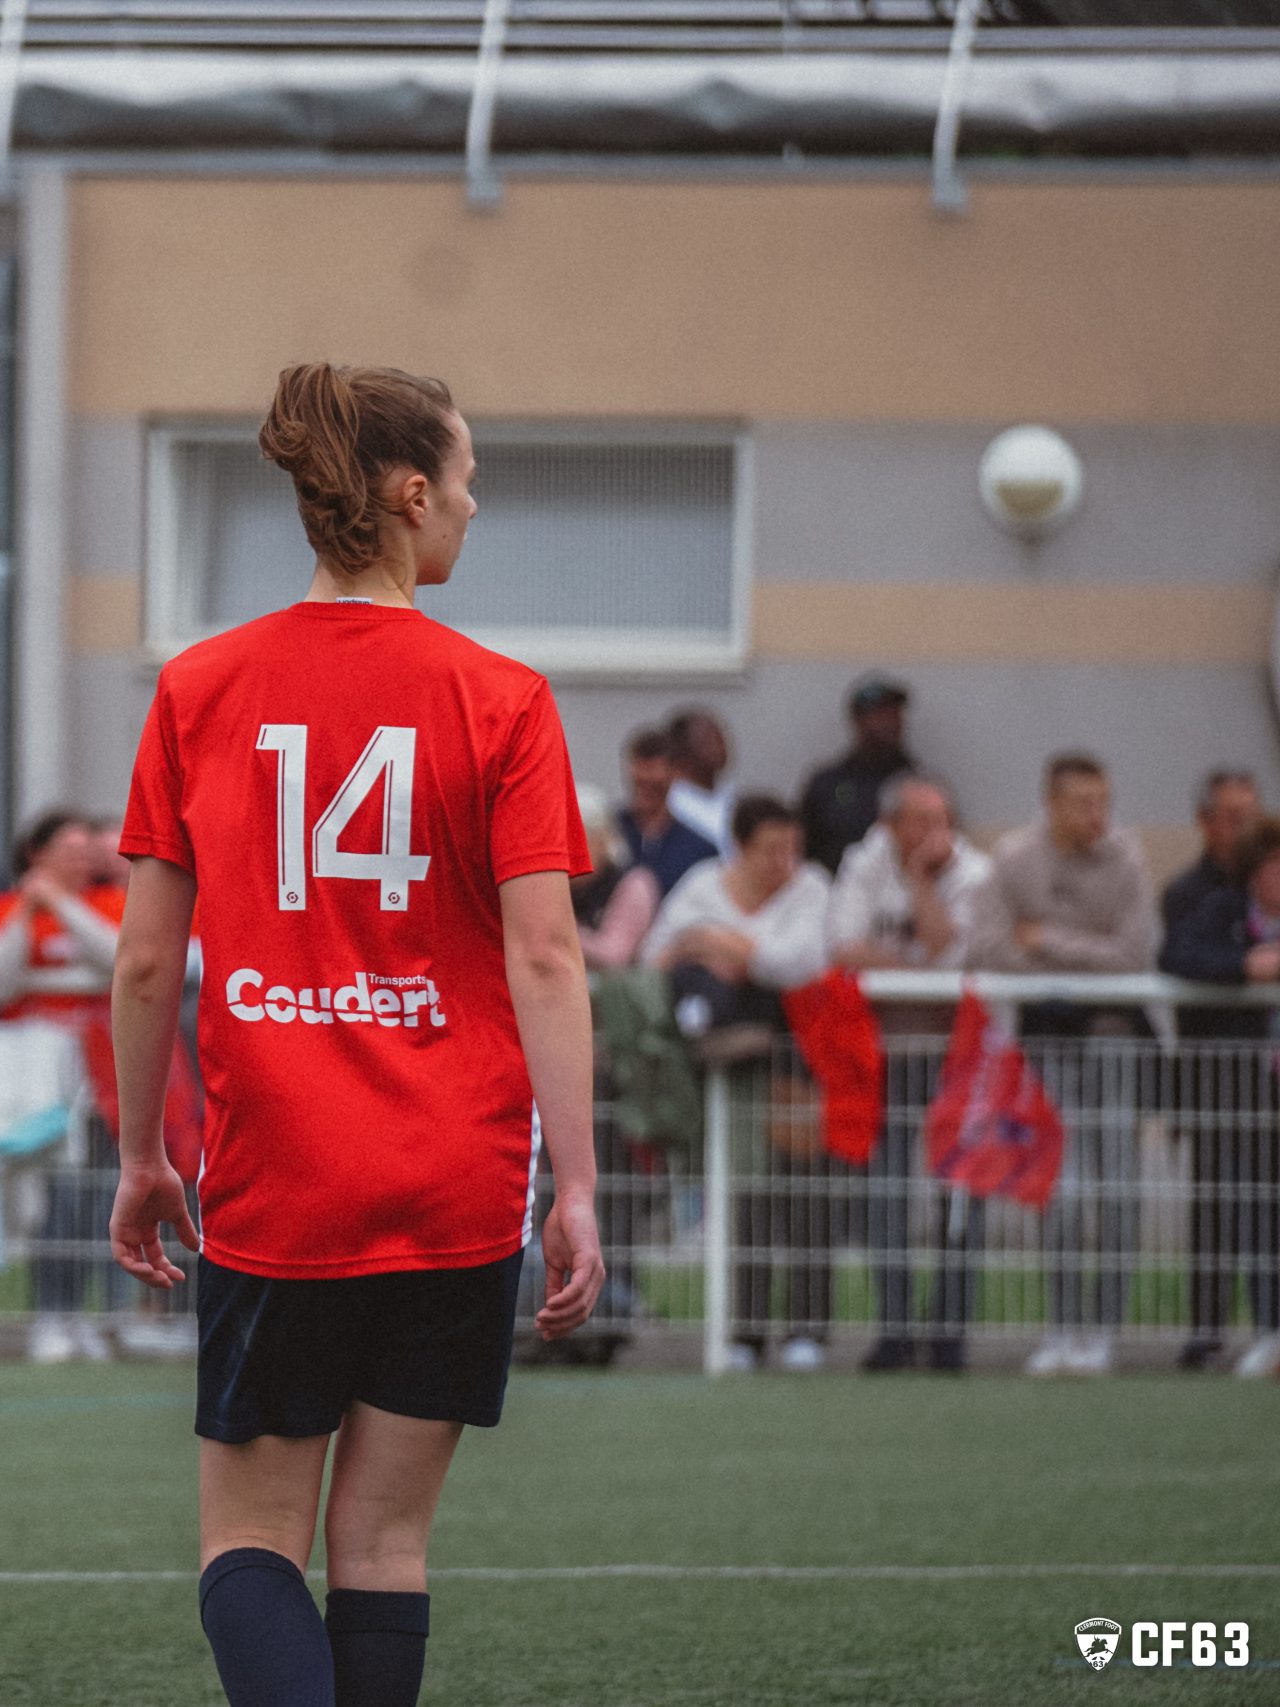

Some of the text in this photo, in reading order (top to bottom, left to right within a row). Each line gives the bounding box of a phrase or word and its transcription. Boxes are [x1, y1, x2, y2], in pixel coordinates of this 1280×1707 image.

[256, 724, 431, 911] 14
[226, 968, 446, 1027] Coudert
[368, 974, 427, 987] Transports
